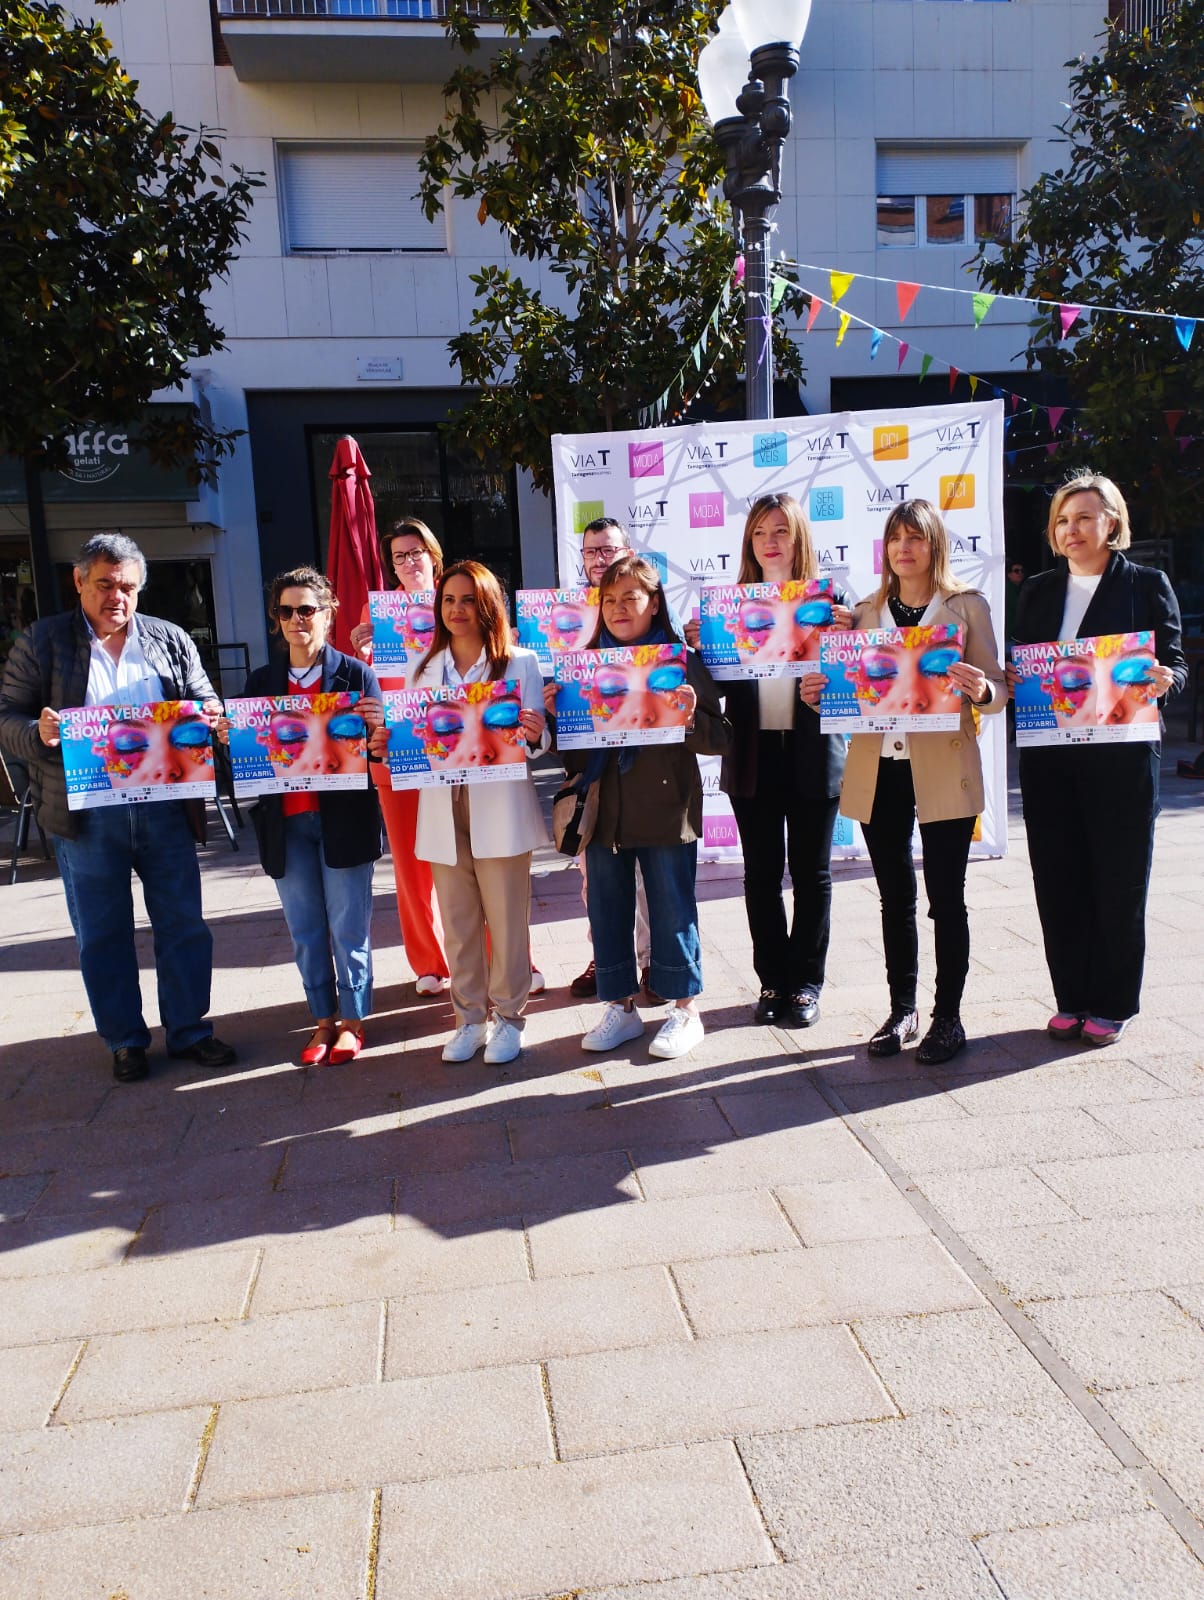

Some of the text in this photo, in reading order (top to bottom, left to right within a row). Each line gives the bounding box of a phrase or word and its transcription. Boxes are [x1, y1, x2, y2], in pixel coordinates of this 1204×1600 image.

[936, 421, 980, 442] VIA T
[807, 432, 849, 451] VIA T
[570, 449, 611, 468] VIA T
[687, 441, 728, 460] VIA T
[73, 456, 101, 467] gelati
[632, 454, 661, 469] MODA
[816, 490, 834, 505] SER
[866, 483, 910, 503] VIA T
[628, 500, 668, 519] VIA T
[693, 504, 721, 519] MODA
[949, 535, 981, 554] IA T
[817, 545, 849, 563] IA T
[689, 553, 730, 572] VIA T
[371, 592, 435, 605] PRIMAVER
[518, 591, 587, 604] PRIMAVERA
[701, 585, 781, 601] PRIMAVERA
[372, 606, 407, 618] SHOW
[518, 606, 553, 617] SHOW
[701, 602, 740, 616] SHOW
[821, 631, 905, 649] PRIMAVERA
[556, 650, 634, 668] PRIMAVERA
[821, 649, 863, 664] SHOW
[1013, 641, 1096, 662] PRIMAVERA
[556, 668, 596, 682] SHOW
[1015, 661, 1055, 677] SHOW
[385, 686, 468, 707] PRIMAVERA
[227, 697, 312, 715] PRIMAVERA
[386, 705, 428, 722] SHOW
[61, 706, 154, 726] PRIMAVERA
[230, 714, 273, 729] SHOW
[62, 723, 110, 740] SHOW
[1016, 721, 1027, 729] 20
[391, 765, 401, 773] 20
[68, 784, 79, 792] 20
[707, 826, 734, 839] MODA
